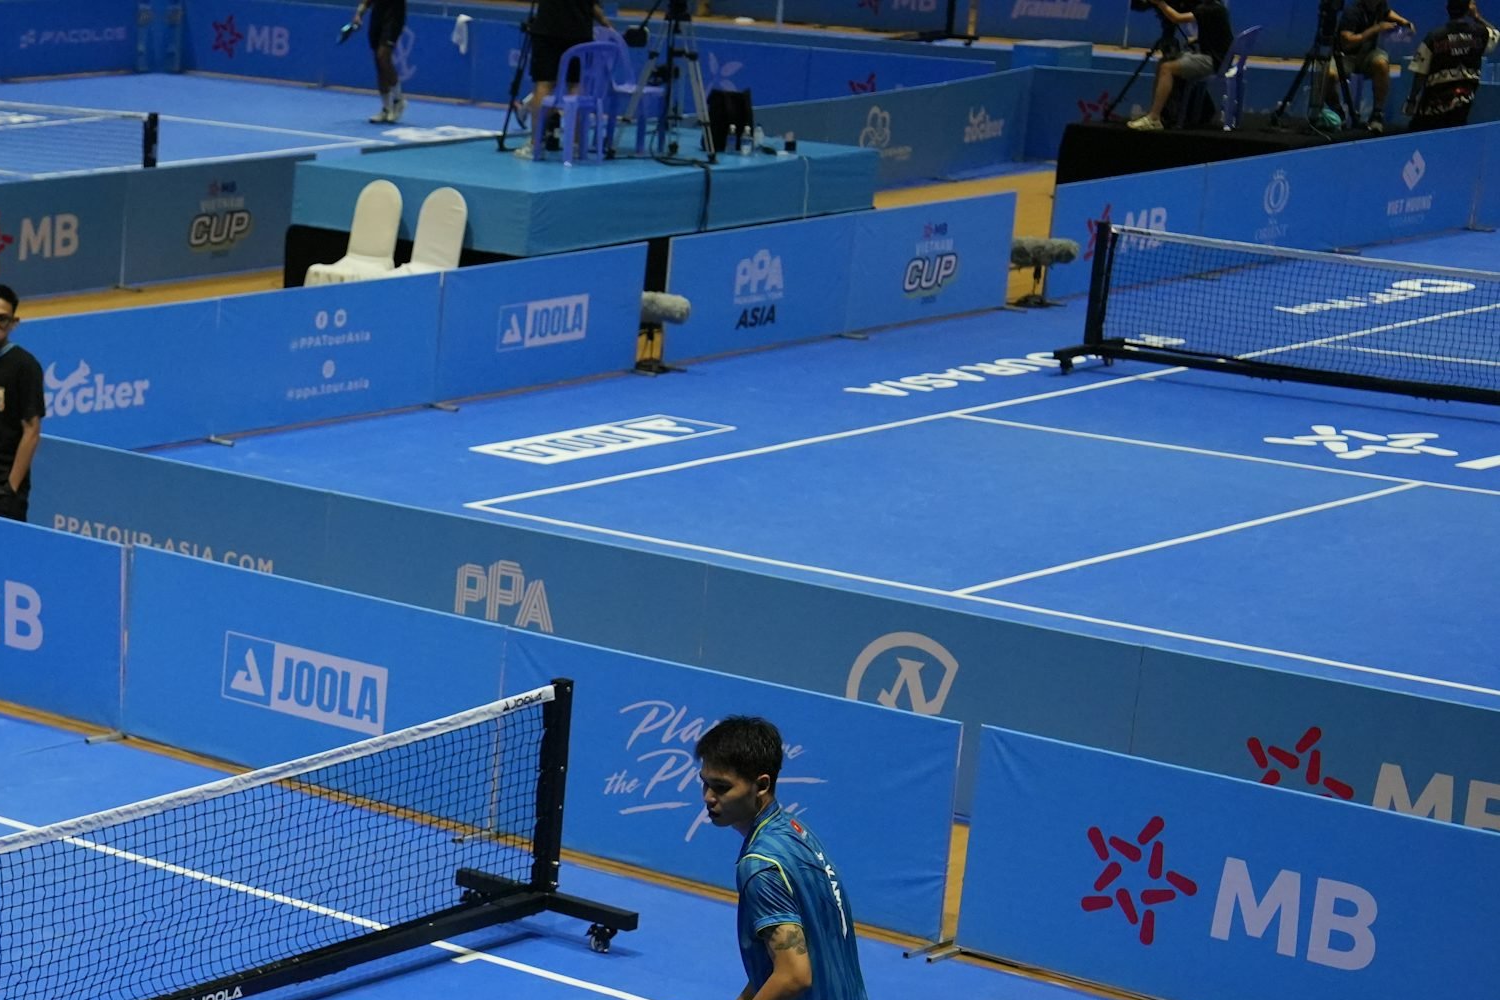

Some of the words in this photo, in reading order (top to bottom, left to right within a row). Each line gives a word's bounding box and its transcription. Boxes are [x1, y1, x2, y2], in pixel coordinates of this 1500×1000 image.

[246, 25, 291, 56] MB
[17, 213, 79, 262] MB
[188, 211, 251, 248] CUP
[903, 252, 958, 293] CUP
[529, 302, 583, 339] JOOLA
[734, 304, 776, 330] ASIA
[454, 559, 554, 633] PPA
[278, 656, 379, 725] JOOLA
[604, 769, 641, 796] the
[1210, 857, 1378, 971] MB
